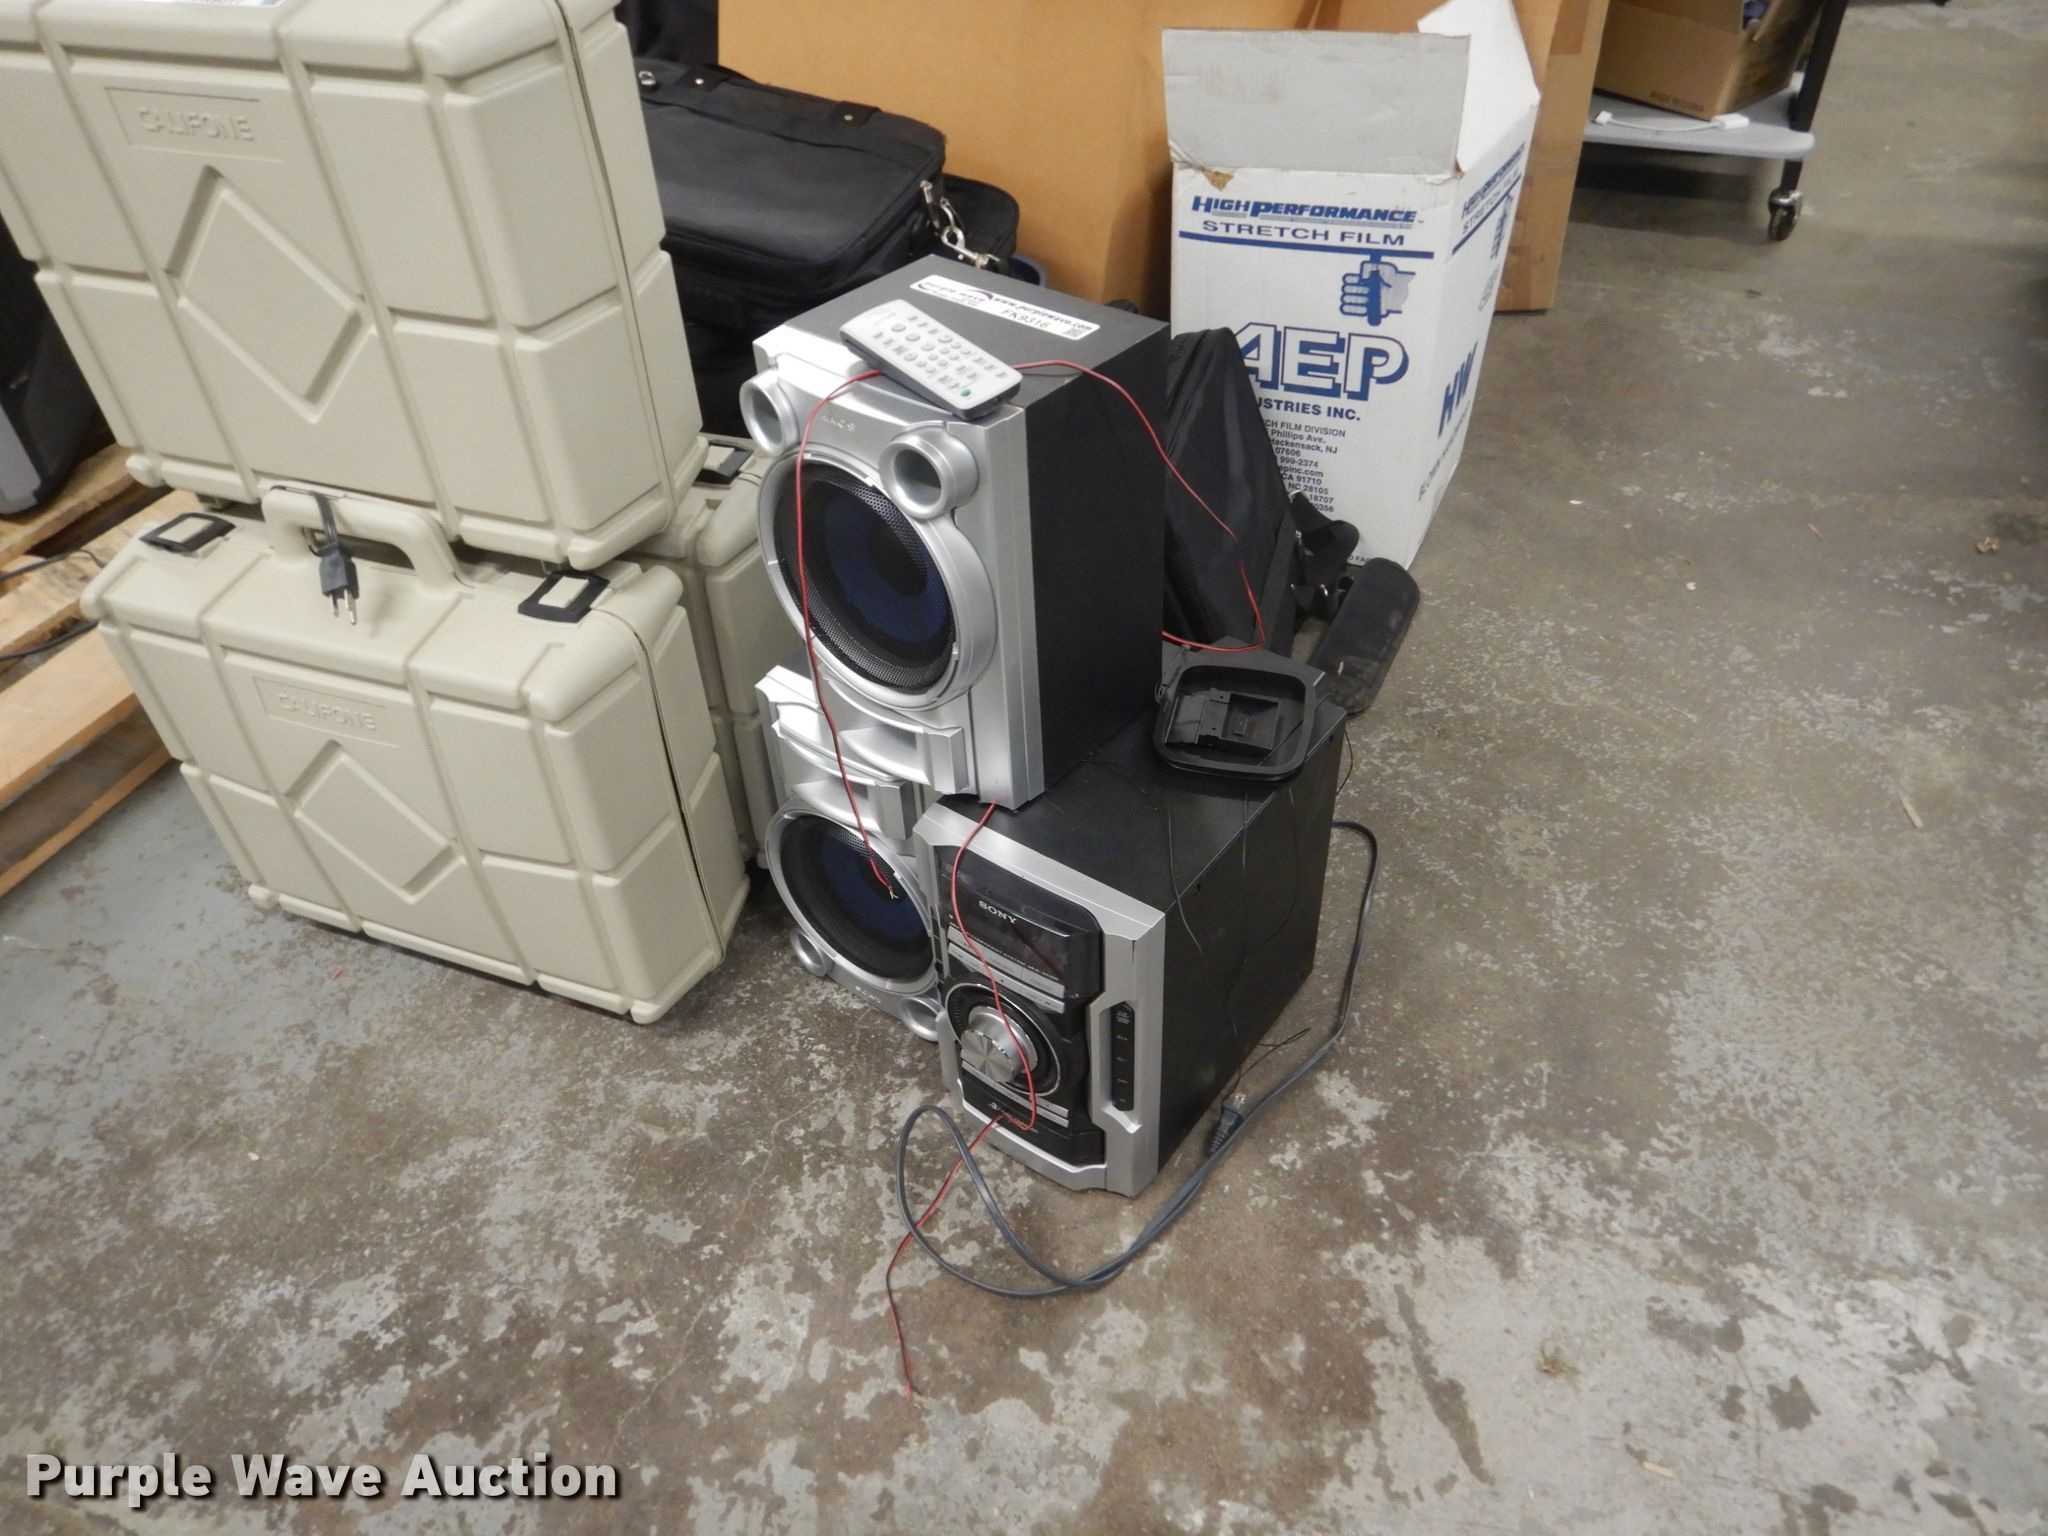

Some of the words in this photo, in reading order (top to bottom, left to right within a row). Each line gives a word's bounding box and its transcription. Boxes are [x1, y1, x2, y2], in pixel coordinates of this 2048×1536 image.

[139, 106, 255, 141] CALIFONE
[1202, 220, 1329, 242] STRETCH
[1339, 231, 1405, 246] FILM
[1232, 322, 1410, 401] AEP
[1438, 341, 1478, 437] HW
[1326, 406, 1361, 421] INC.
[1271, 428, 1304, 441] Phillips
[1306, 434, 1326, 444] Ave.
[1280, 421, 1303, 431] FILM
[1304, 425, 1347, 438] DIVISION
[1325, 445, 1338, 454] NJ
[1288, 482, 1301, 490] NC
[1295, 476, 1322, 486] 91710
[278, 692, 377, 731] CALIFONE
[978, 900, 1017, 924] SONY
